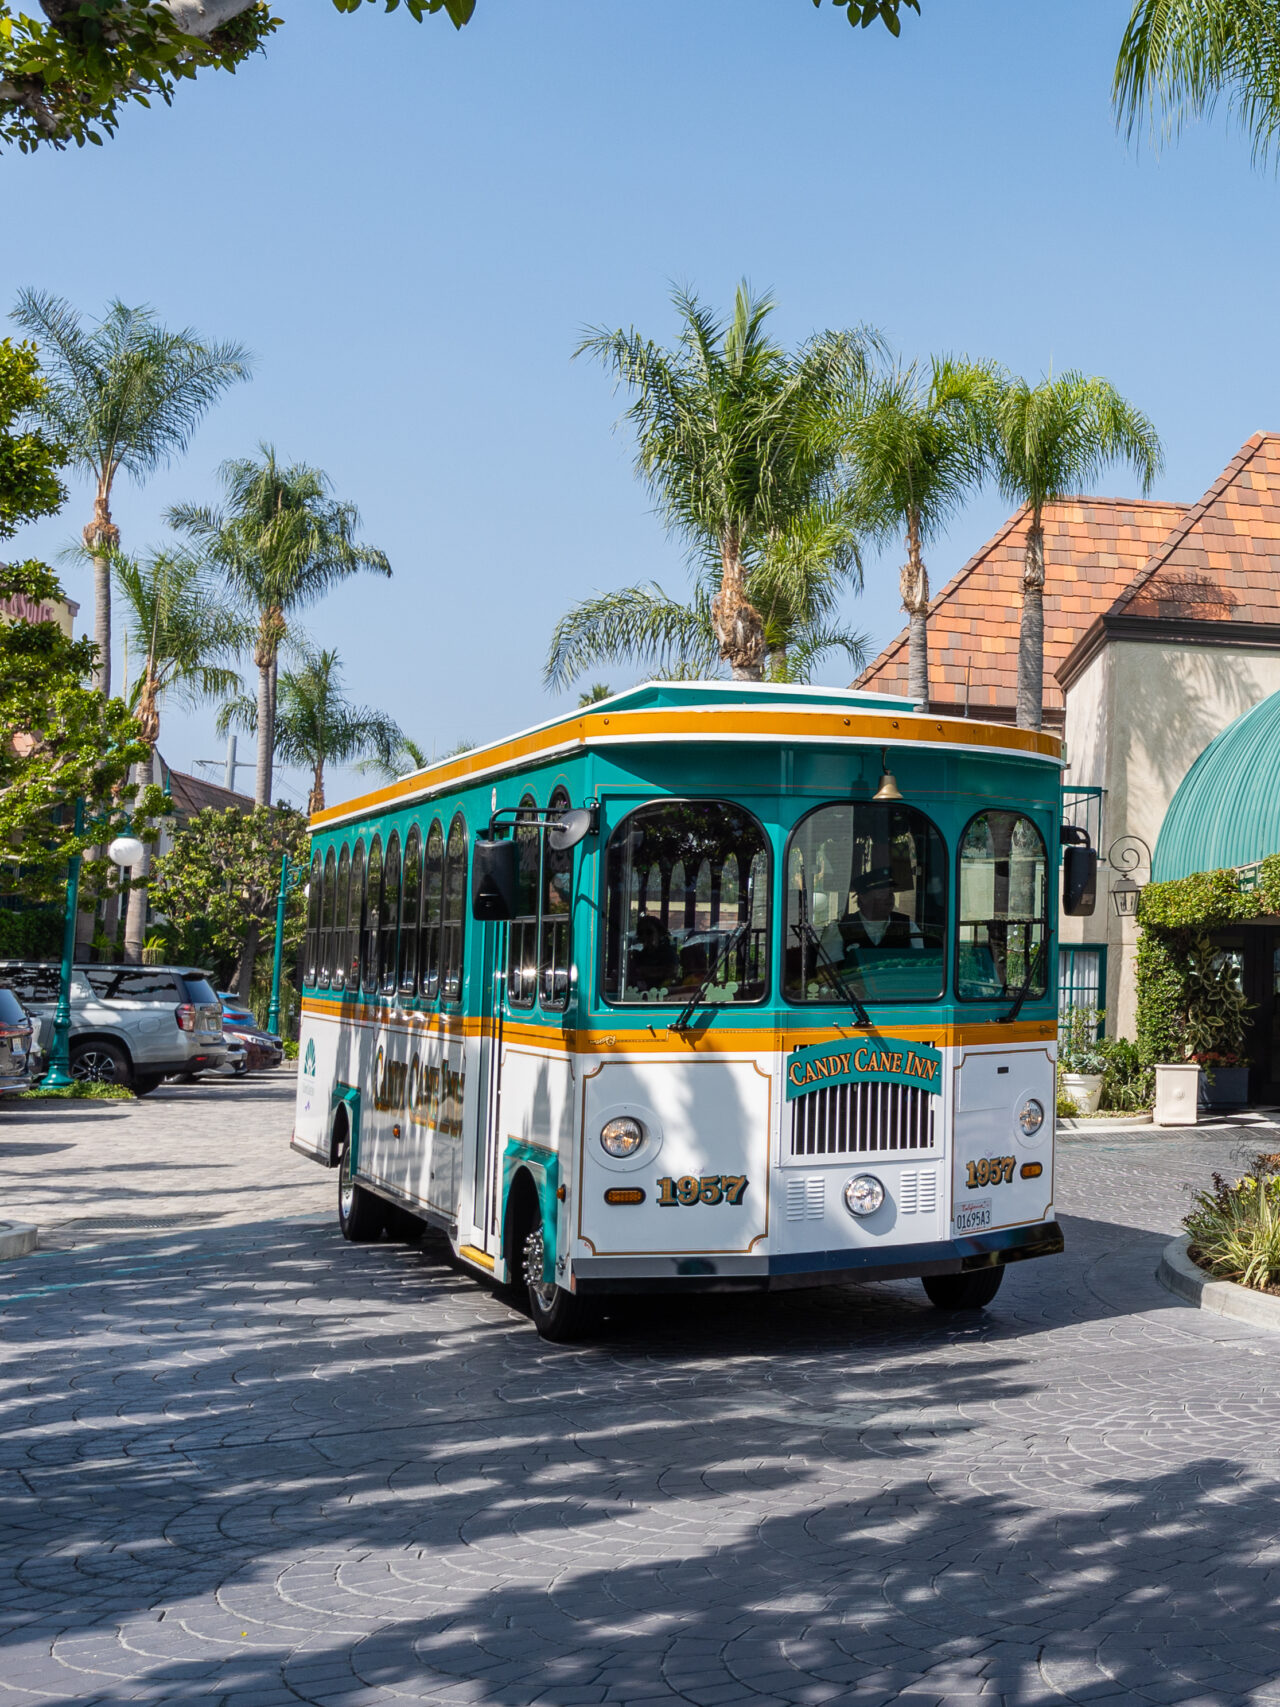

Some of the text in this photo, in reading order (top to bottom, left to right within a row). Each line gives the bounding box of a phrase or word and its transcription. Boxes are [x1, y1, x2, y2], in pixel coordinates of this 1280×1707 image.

[789, 1047, 939, 1087] CANDY CANE INN
[965, 1155, 1017, 1190] 1957
[655, 1174, 750, 1207] 1957
[956, 1209, 991, 1230] 01695A3
